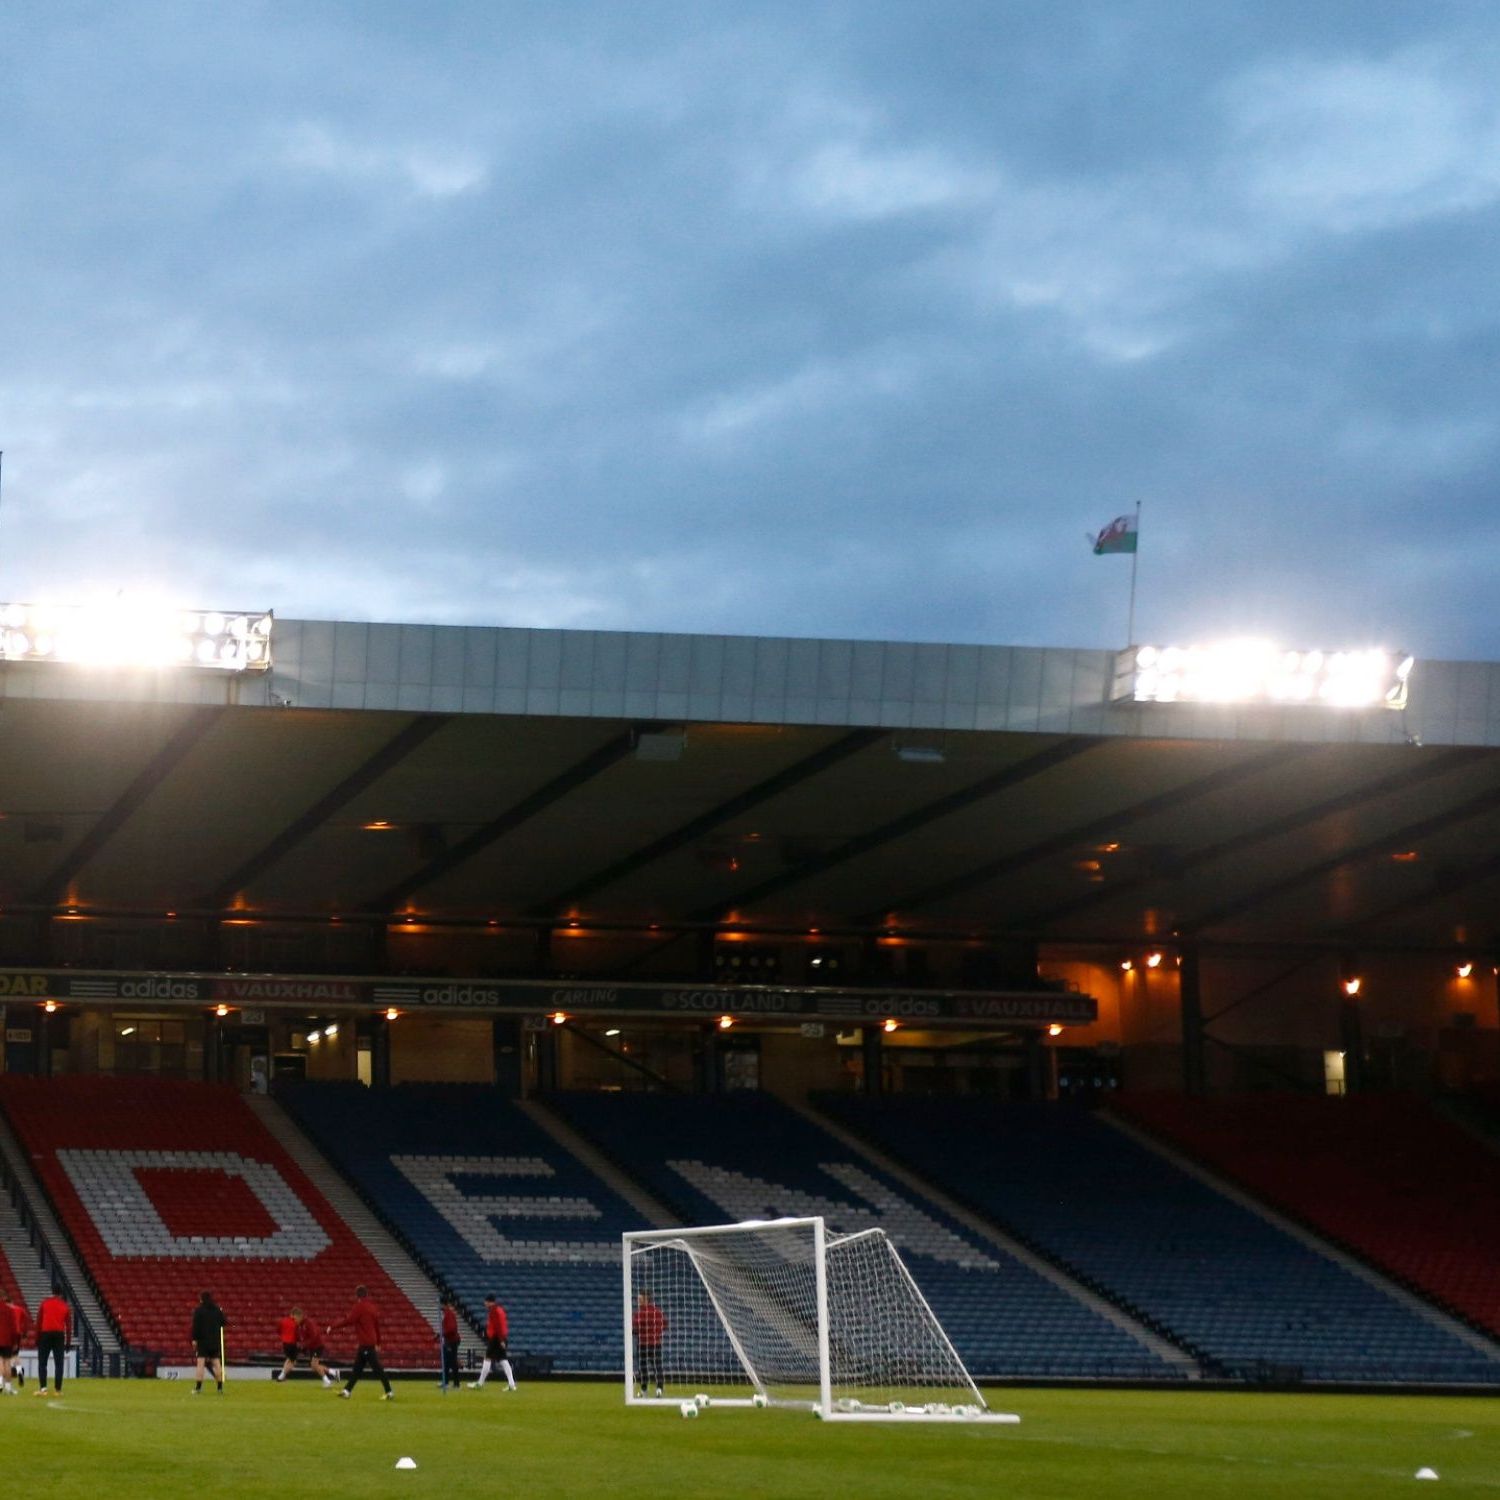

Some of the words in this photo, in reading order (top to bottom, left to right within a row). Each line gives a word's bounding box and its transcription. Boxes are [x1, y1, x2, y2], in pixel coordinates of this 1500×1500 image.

[121, 979, 199, 999] adidas
[233, 983, 357, 999] VAUXHALL
[423, 986, 500, 1006] adidas
[552, 988, 618, 1005] CARLING
[677, 991, 786, 1011] SCOTLAND
[866, 997, 940, 1016] adidas
[972, 1000, 1093, 1017] VAUXHALL
